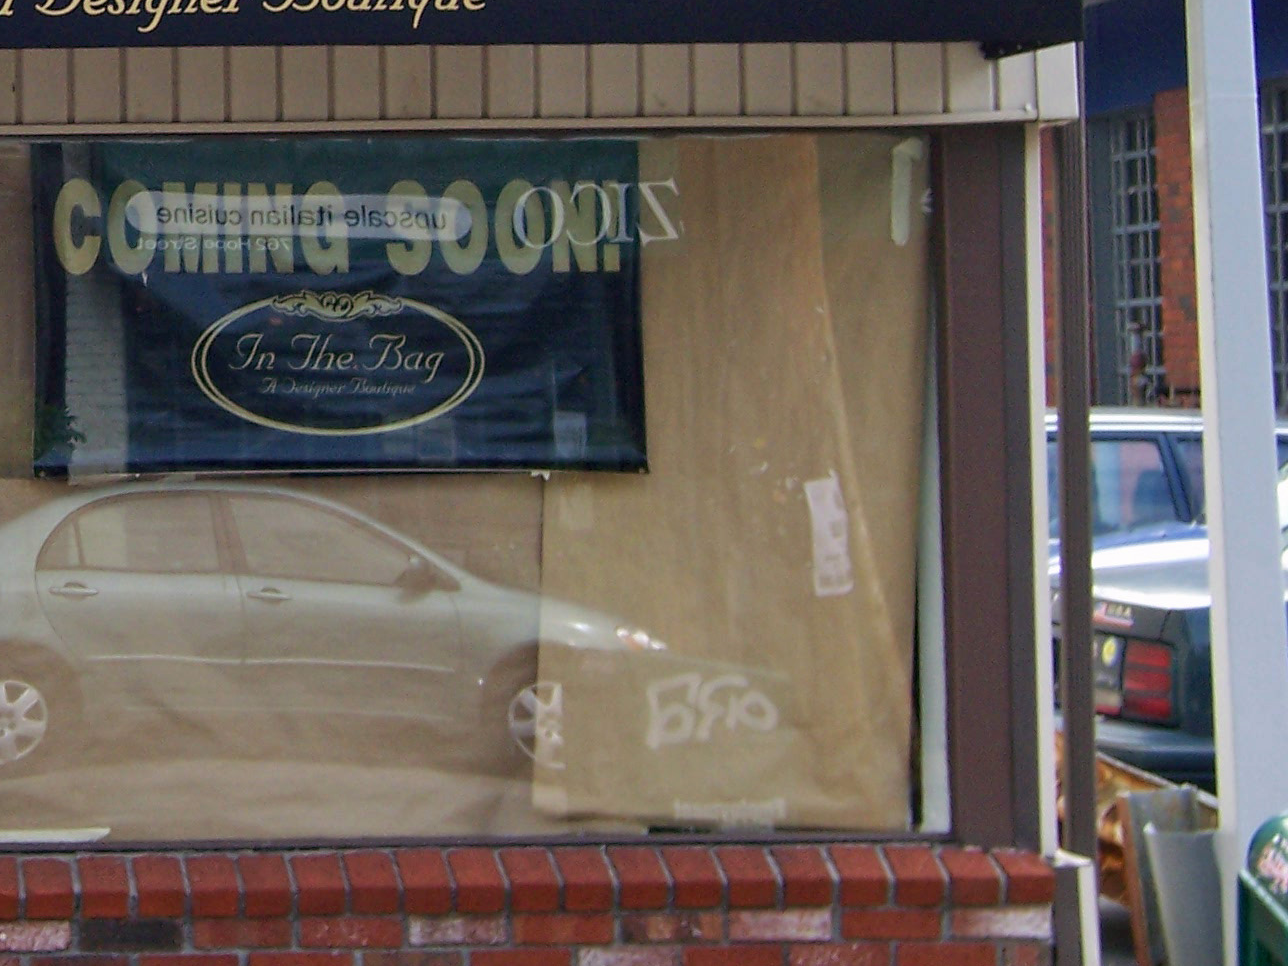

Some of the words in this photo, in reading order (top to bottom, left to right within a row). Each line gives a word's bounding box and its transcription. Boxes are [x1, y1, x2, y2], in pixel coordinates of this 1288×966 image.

[53, 179, 350, 276] COMING
[387, 180, 622, 275] SOON!
[227, 333, 275, 371] In
[287, 333, 354, 371] The
[362, 334, 445, 384] Bag
